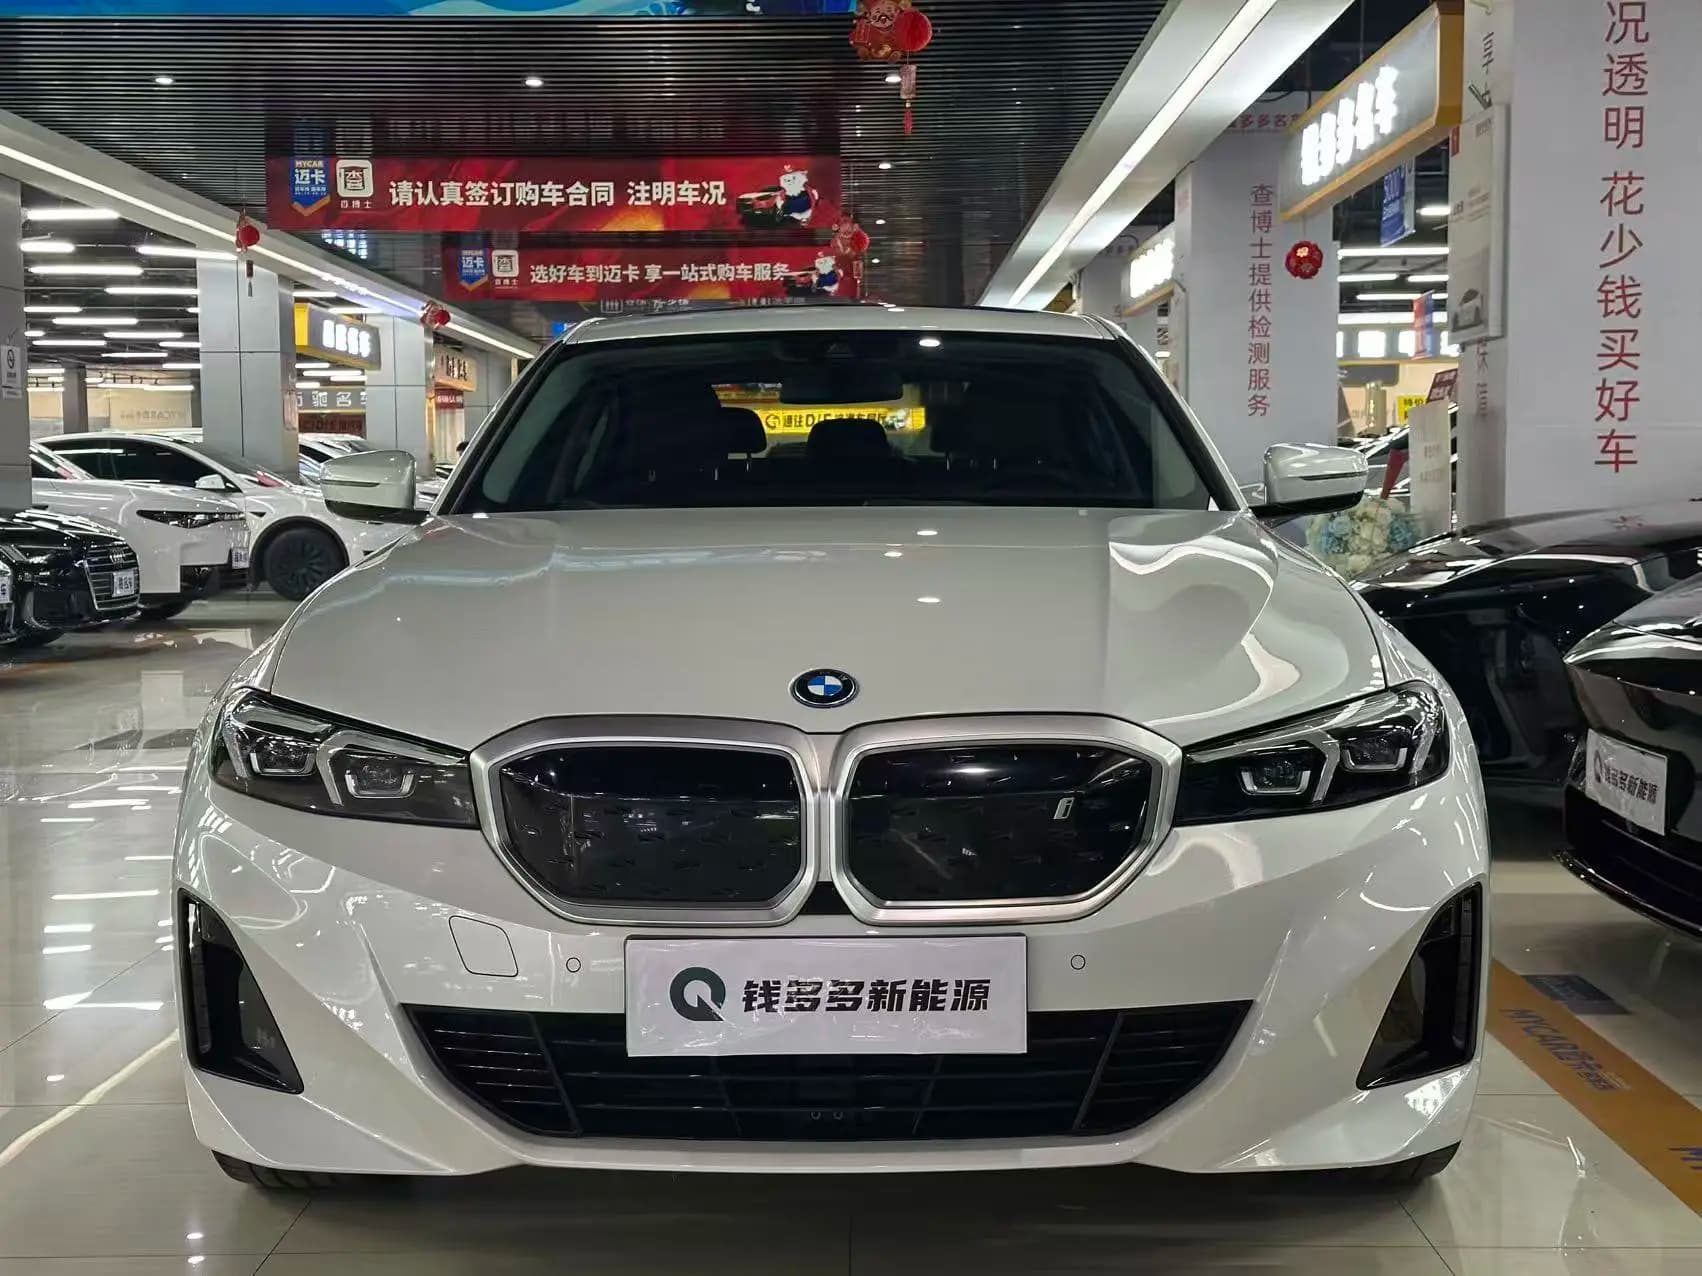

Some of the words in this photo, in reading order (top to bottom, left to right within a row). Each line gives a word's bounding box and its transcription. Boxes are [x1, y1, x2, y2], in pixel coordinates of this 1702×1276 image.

[294, 168, 326, 185] 迈卡
[389, 181, 615, 207] 请认真签订购车合同
[627, 181, 727, 207] 注明车况
[462, 257, 485, 269] 迈卡
[530, 264, 640, 284] 选好车到迈卡
[644, 263, 790, 283] 享一站式购车服务
[1247, 184, 1274, 417] 查博士提供检测服务
[1595, 170, 1644, 473] 花少钱买好车
[742, 978, 991, 1013] 钱多多新能源
